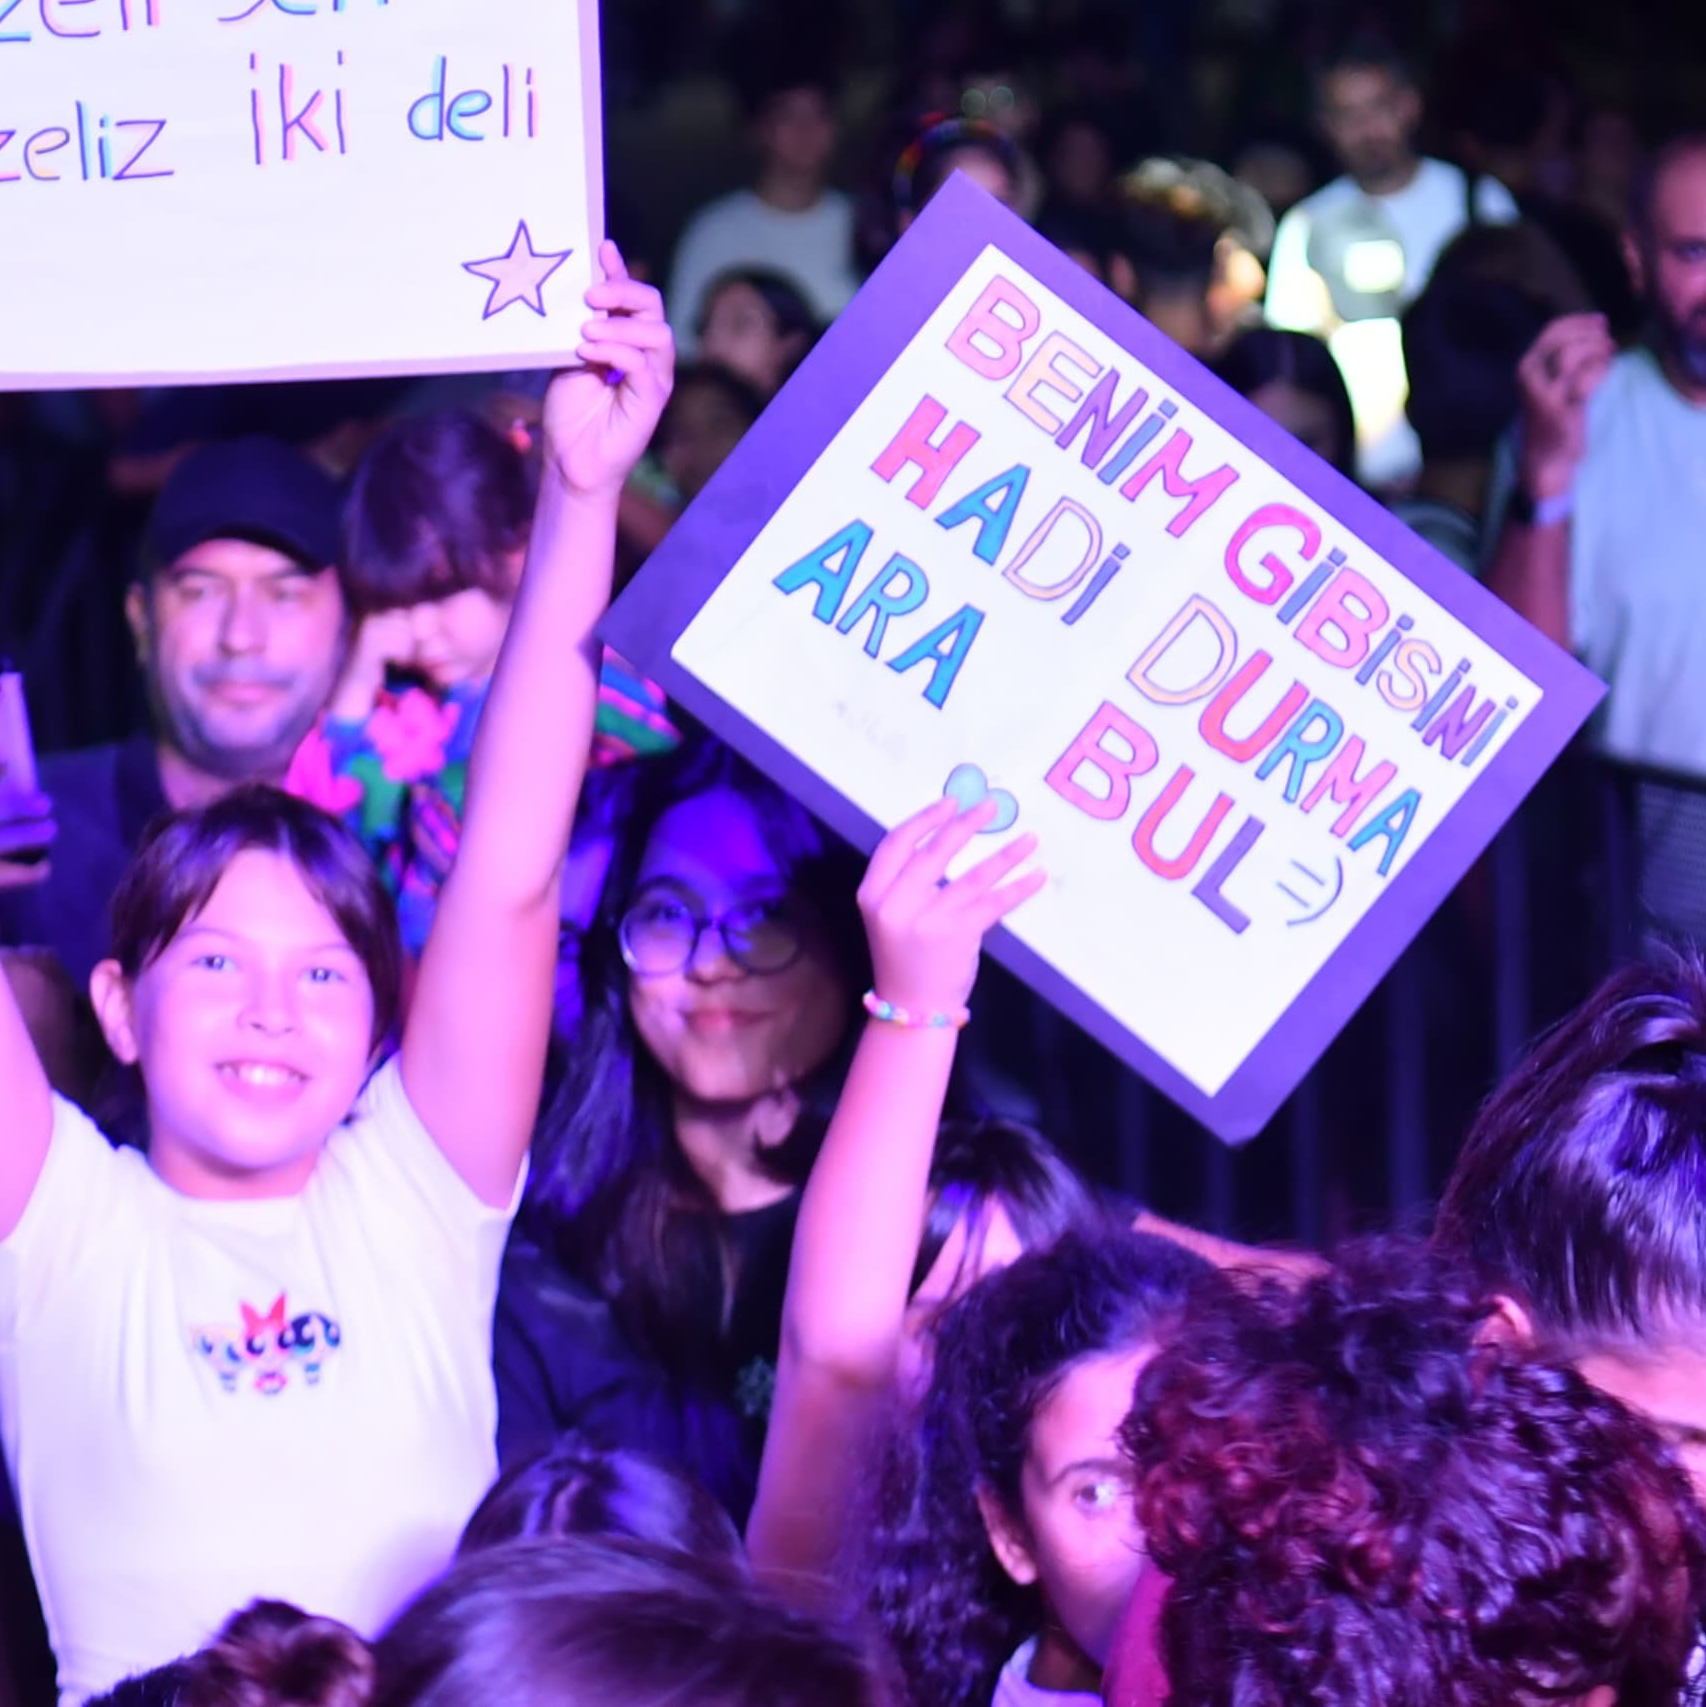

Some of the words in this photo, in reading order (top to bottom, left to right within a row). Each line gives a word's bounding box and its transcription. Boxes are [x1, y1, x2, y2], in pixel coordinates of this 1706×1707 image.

[407, 55, 541, 141] deli
[771, 518, 987, 711] ARA
[1043, 700, 1267, 937] BUL
[1125, 593, 1424, 878] DURMA
